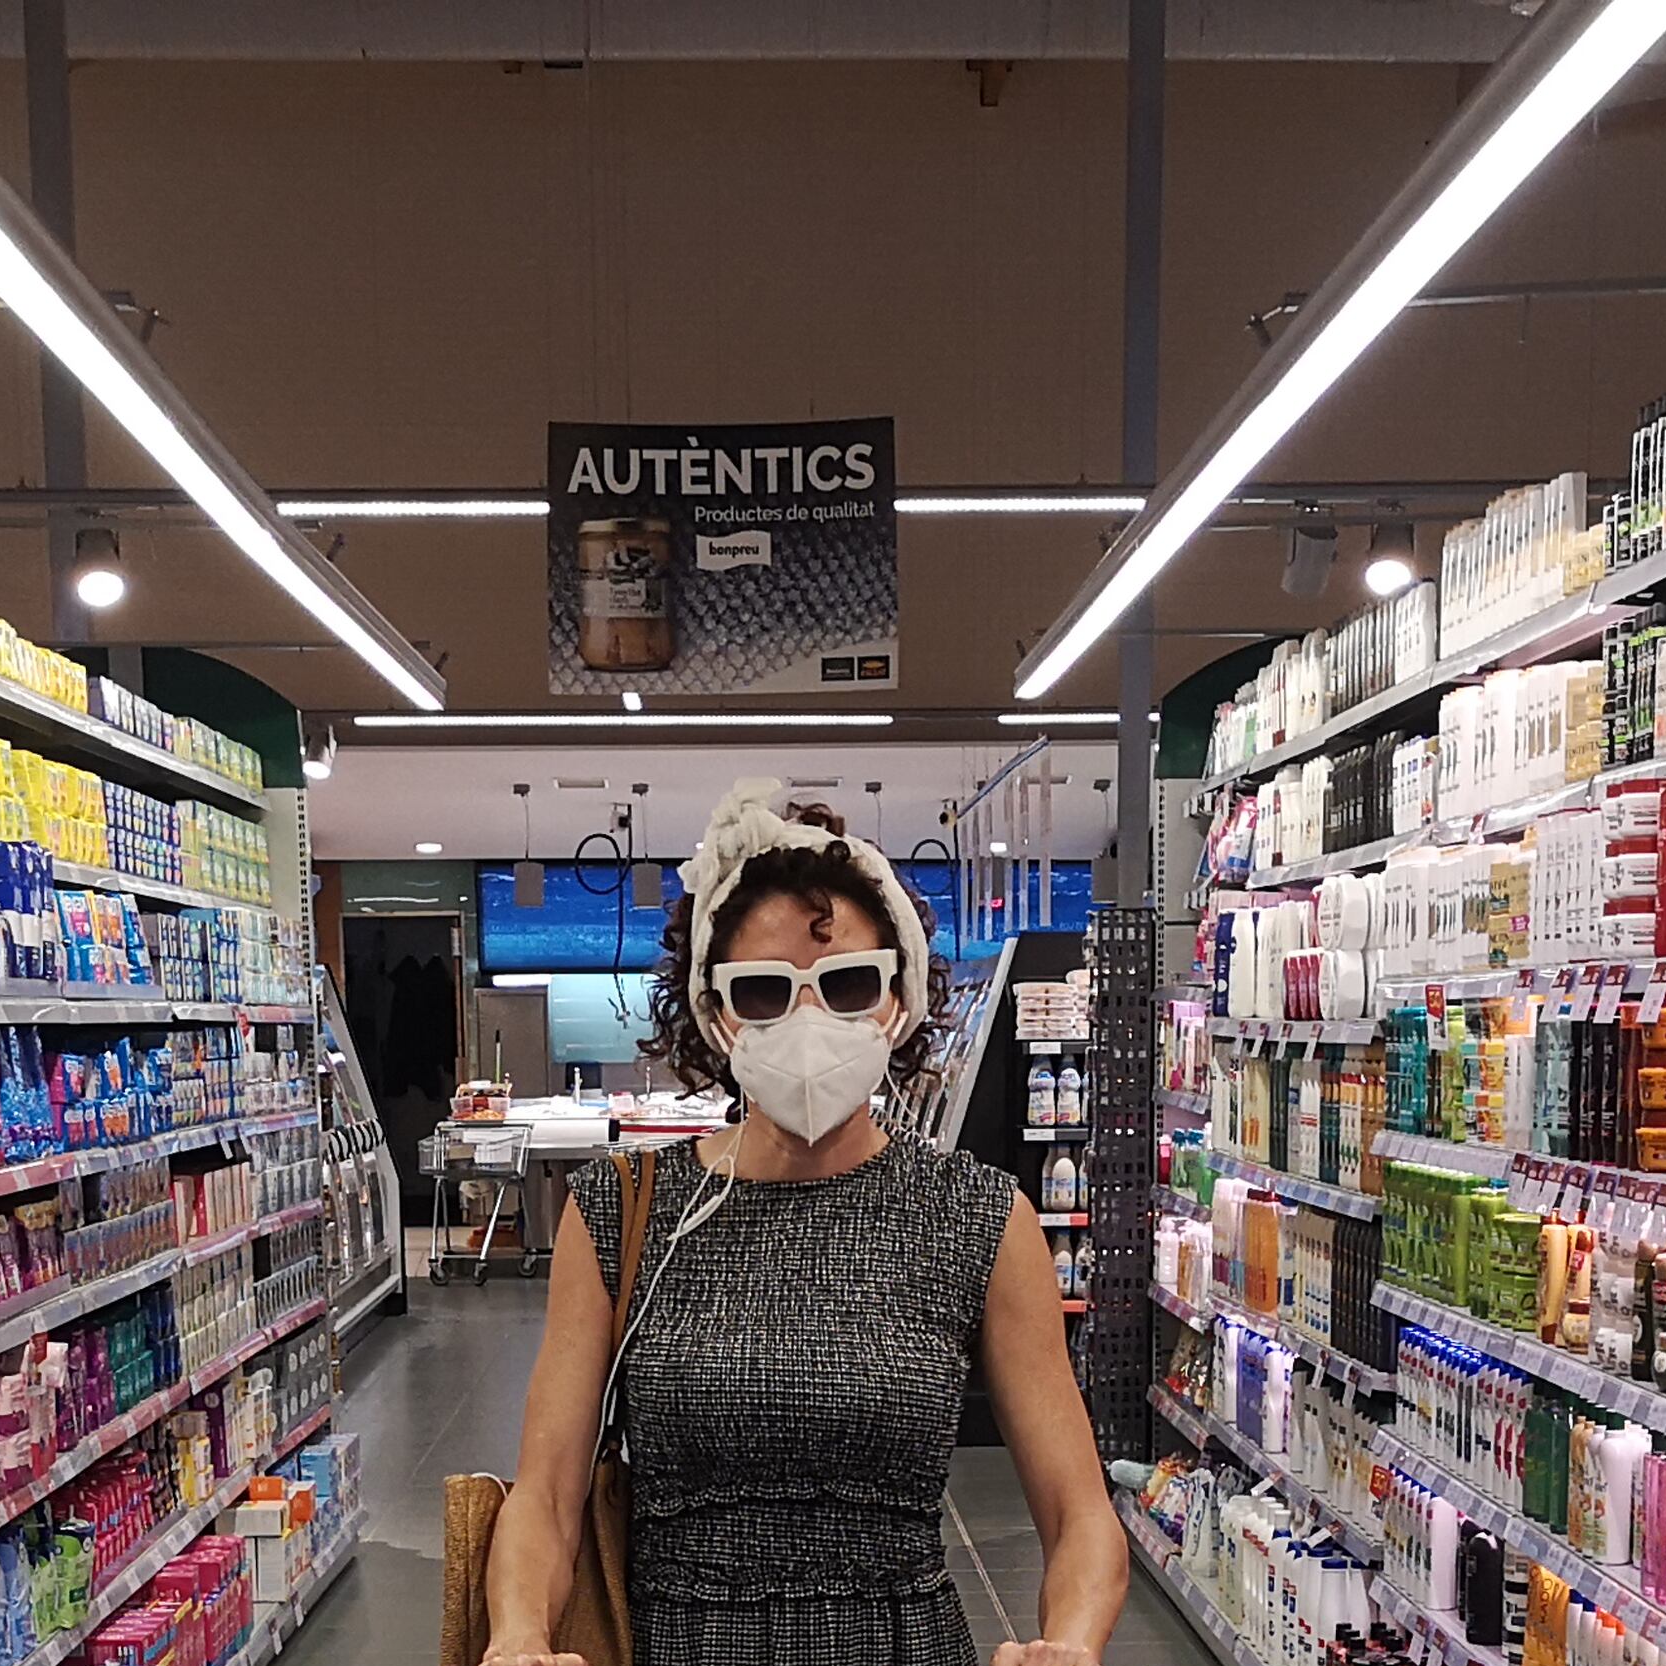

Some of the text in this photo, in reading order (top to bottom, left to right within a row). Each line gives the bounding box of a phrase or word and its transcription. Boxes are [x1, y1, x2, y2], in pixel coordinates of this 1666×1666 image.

[567, 437, 875, 495] AUTÈNTICS
[694, 501, 875, 524] Productes de qualitat
[709, 532, 760, 558] bonpreu
